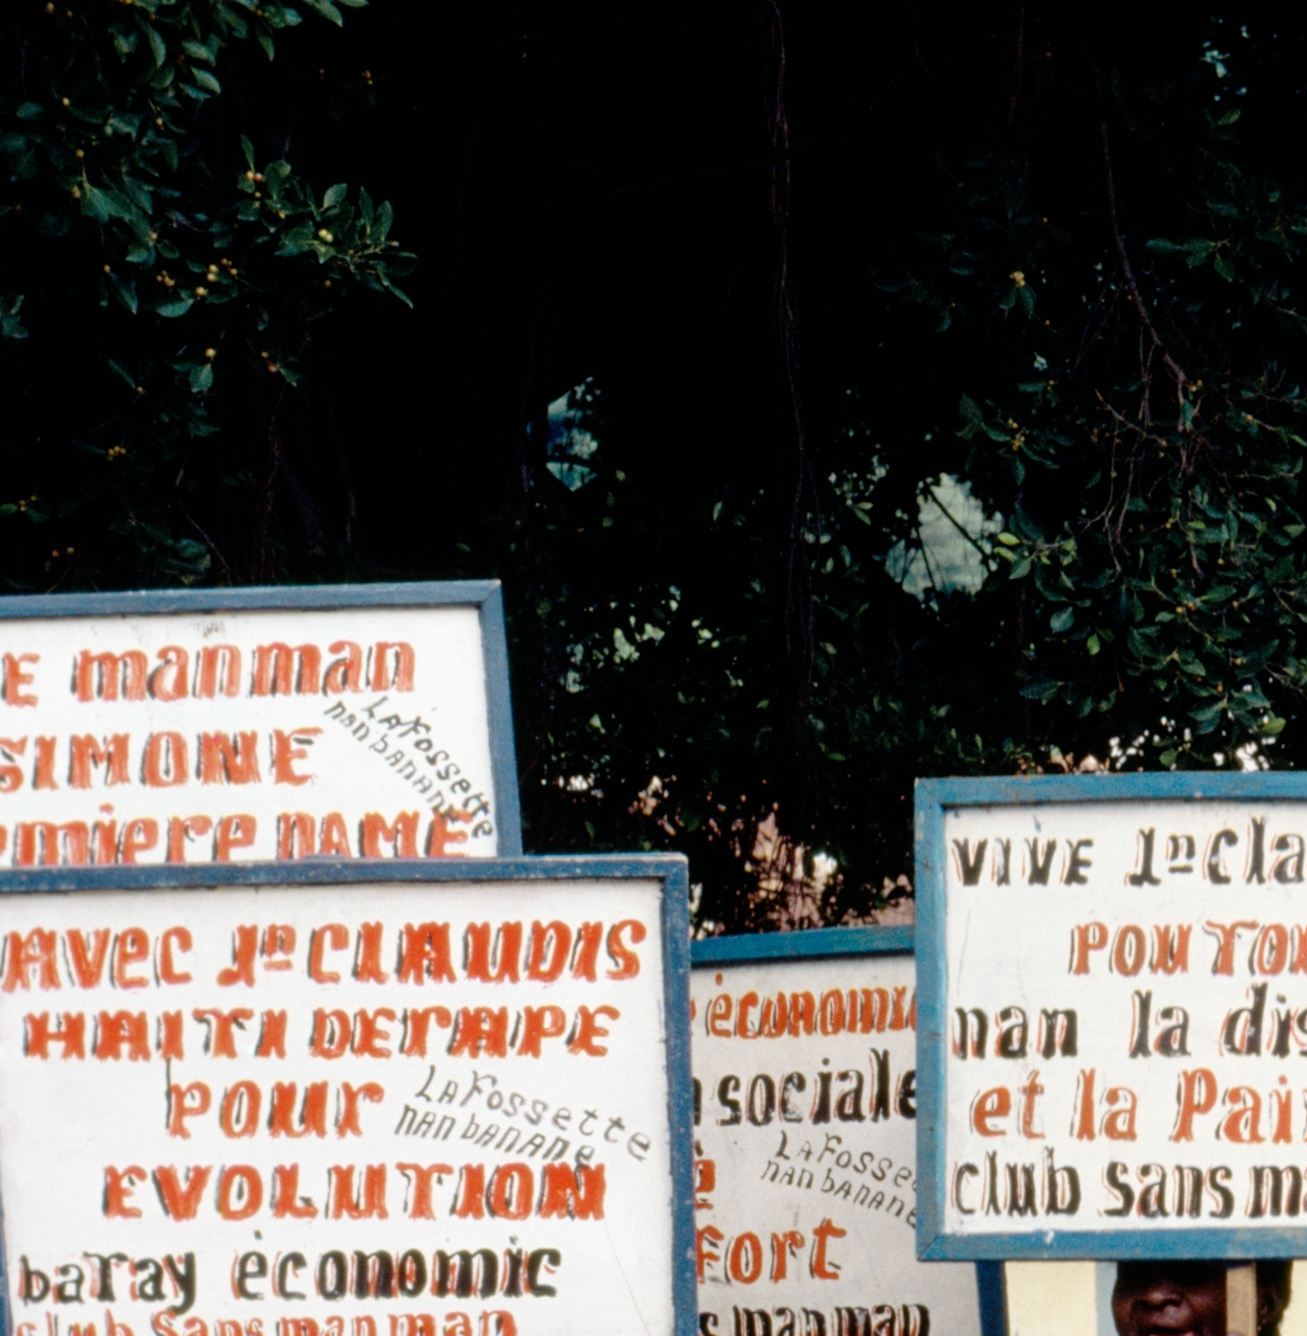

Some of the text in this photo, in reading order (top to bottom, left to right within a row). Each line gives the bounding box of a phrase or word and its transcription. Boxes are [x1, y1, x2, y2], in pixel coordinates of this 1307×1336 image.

[71, 641, 416, 703] manman
[0, 727, 324, 794] SIMONE
[23, 1007, 287, 1062] HAITI
[952, 1003, 1079, 1061] nan
[1129, 989, 1191, 1060] la
[716, 1047, 917, 1127] sociale
[971, 1070, 1046, 1140] et
[1070, 1066, 1138, 1143] la
[102, 1162, 607, 1222] EVOLUTION
[954, 1146, 1082, 1218] club
